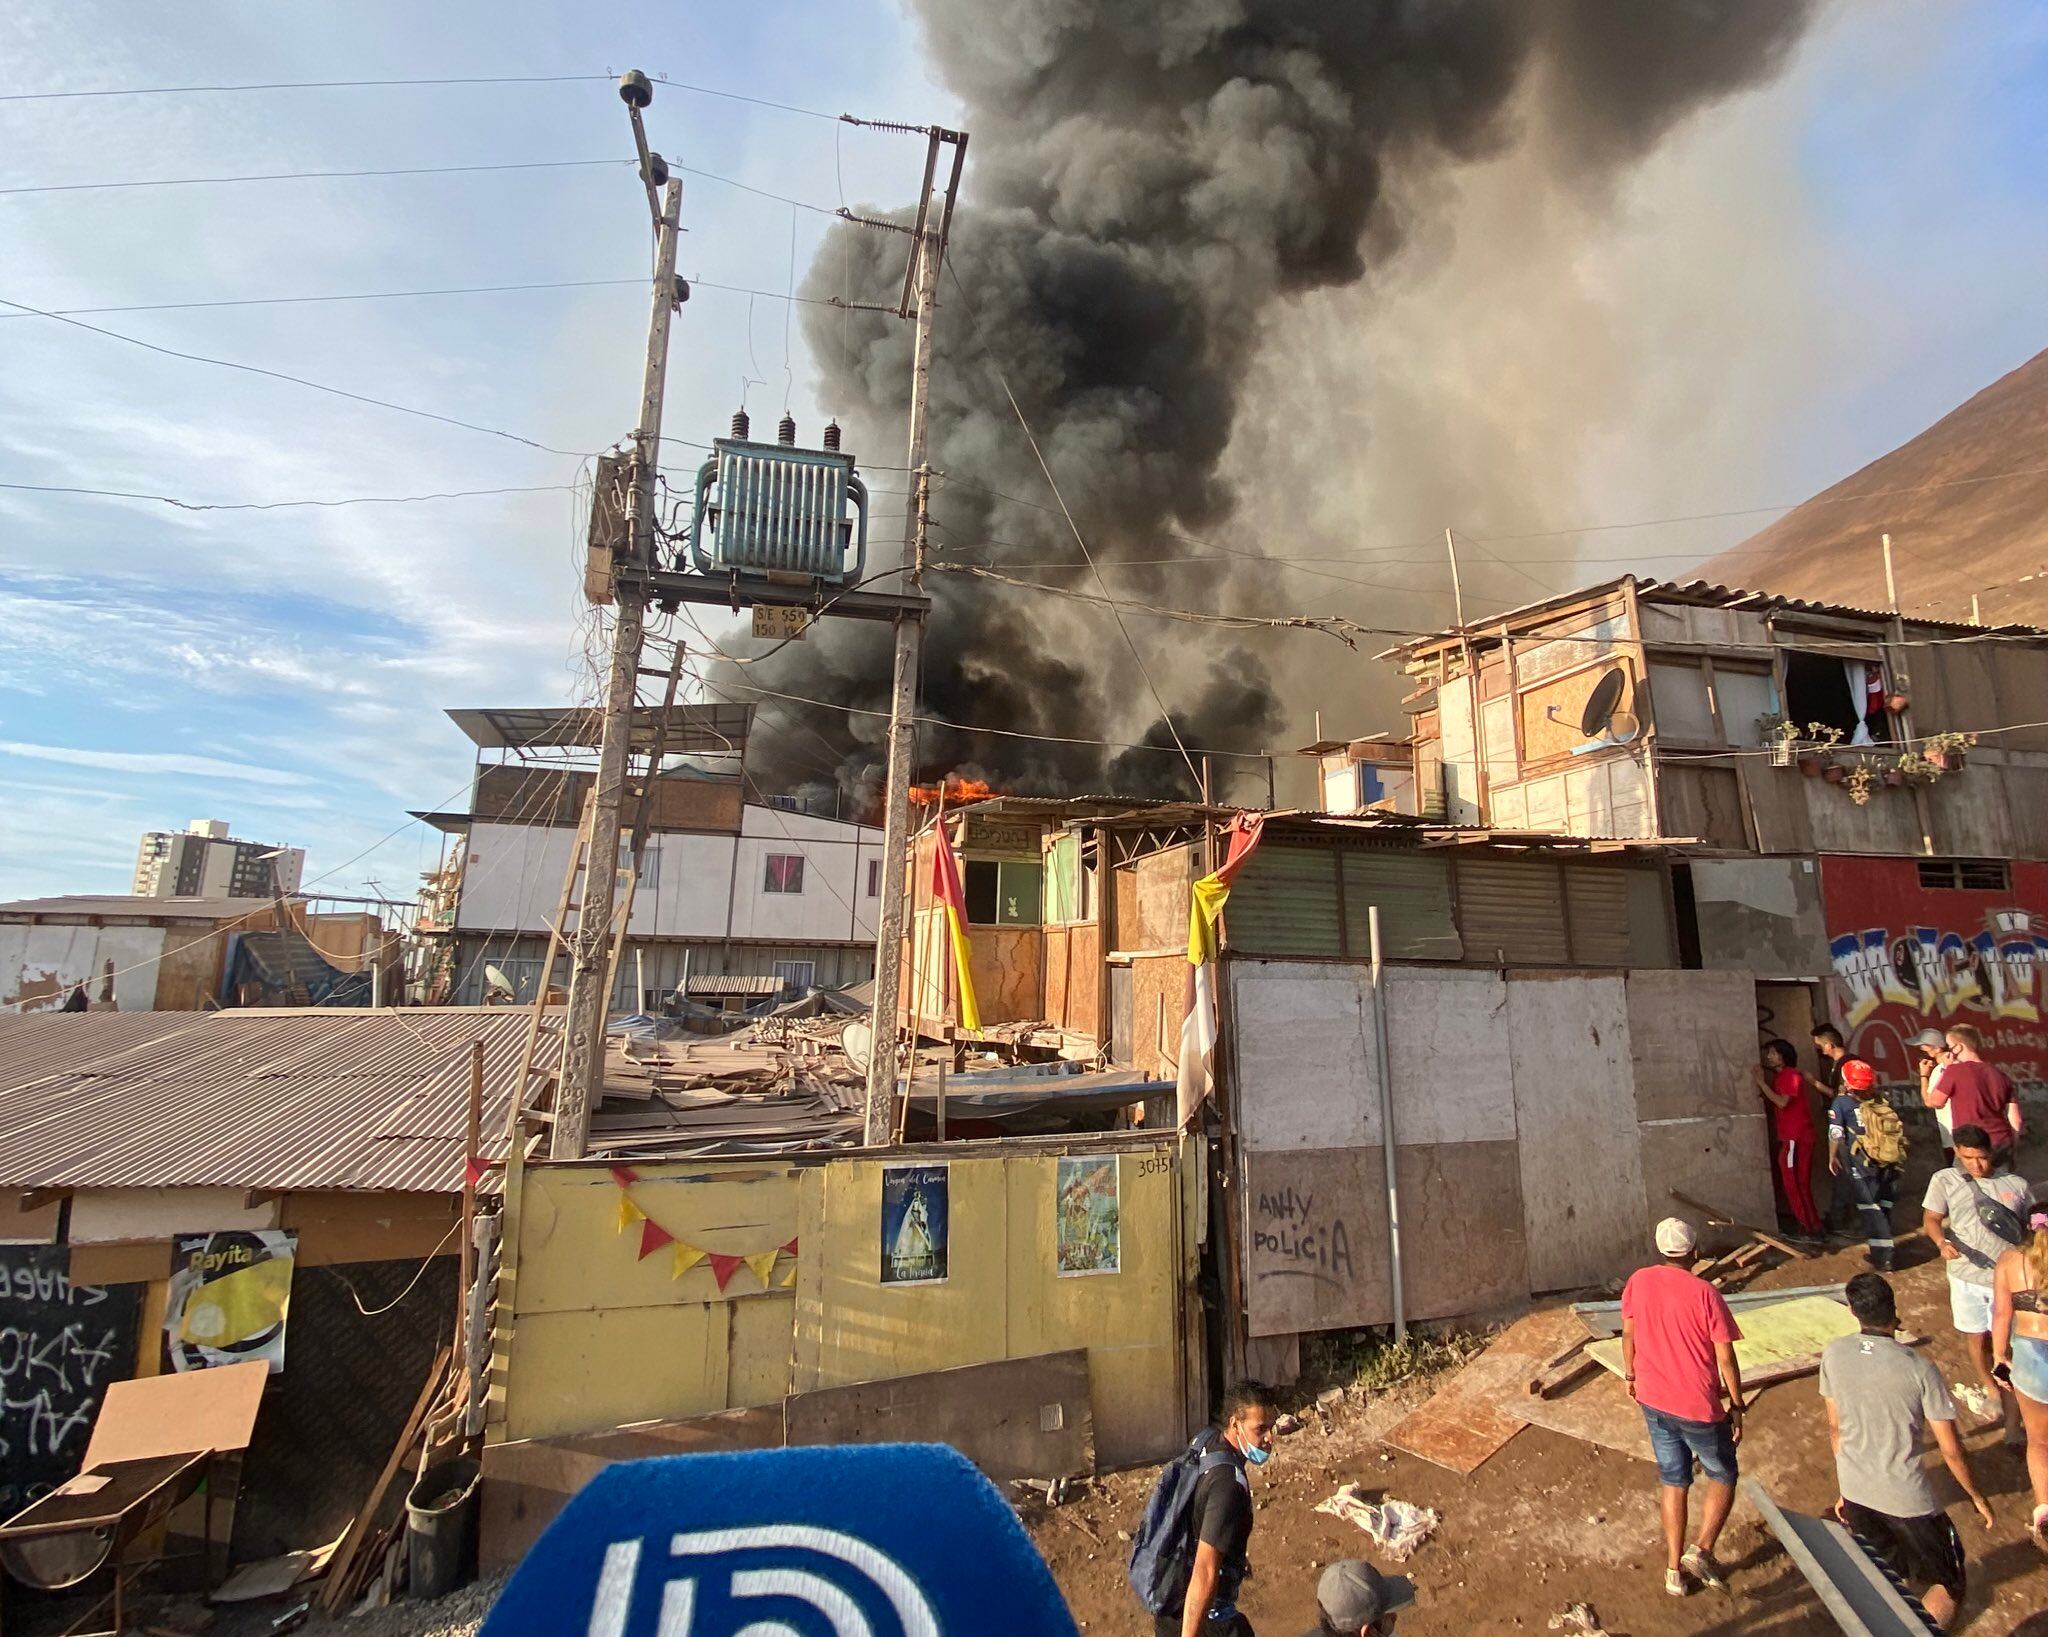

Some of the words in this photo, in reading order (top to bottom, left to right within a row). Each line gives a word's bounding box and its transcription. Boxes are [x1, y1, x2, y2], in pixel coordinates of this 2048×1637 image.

[756, 624, 776, 636] 150
[784, 624, 804, 638] KV
[1138, 1157, 1168, 1178] 3075
[190, 1244, 252, 1271] Rayita
